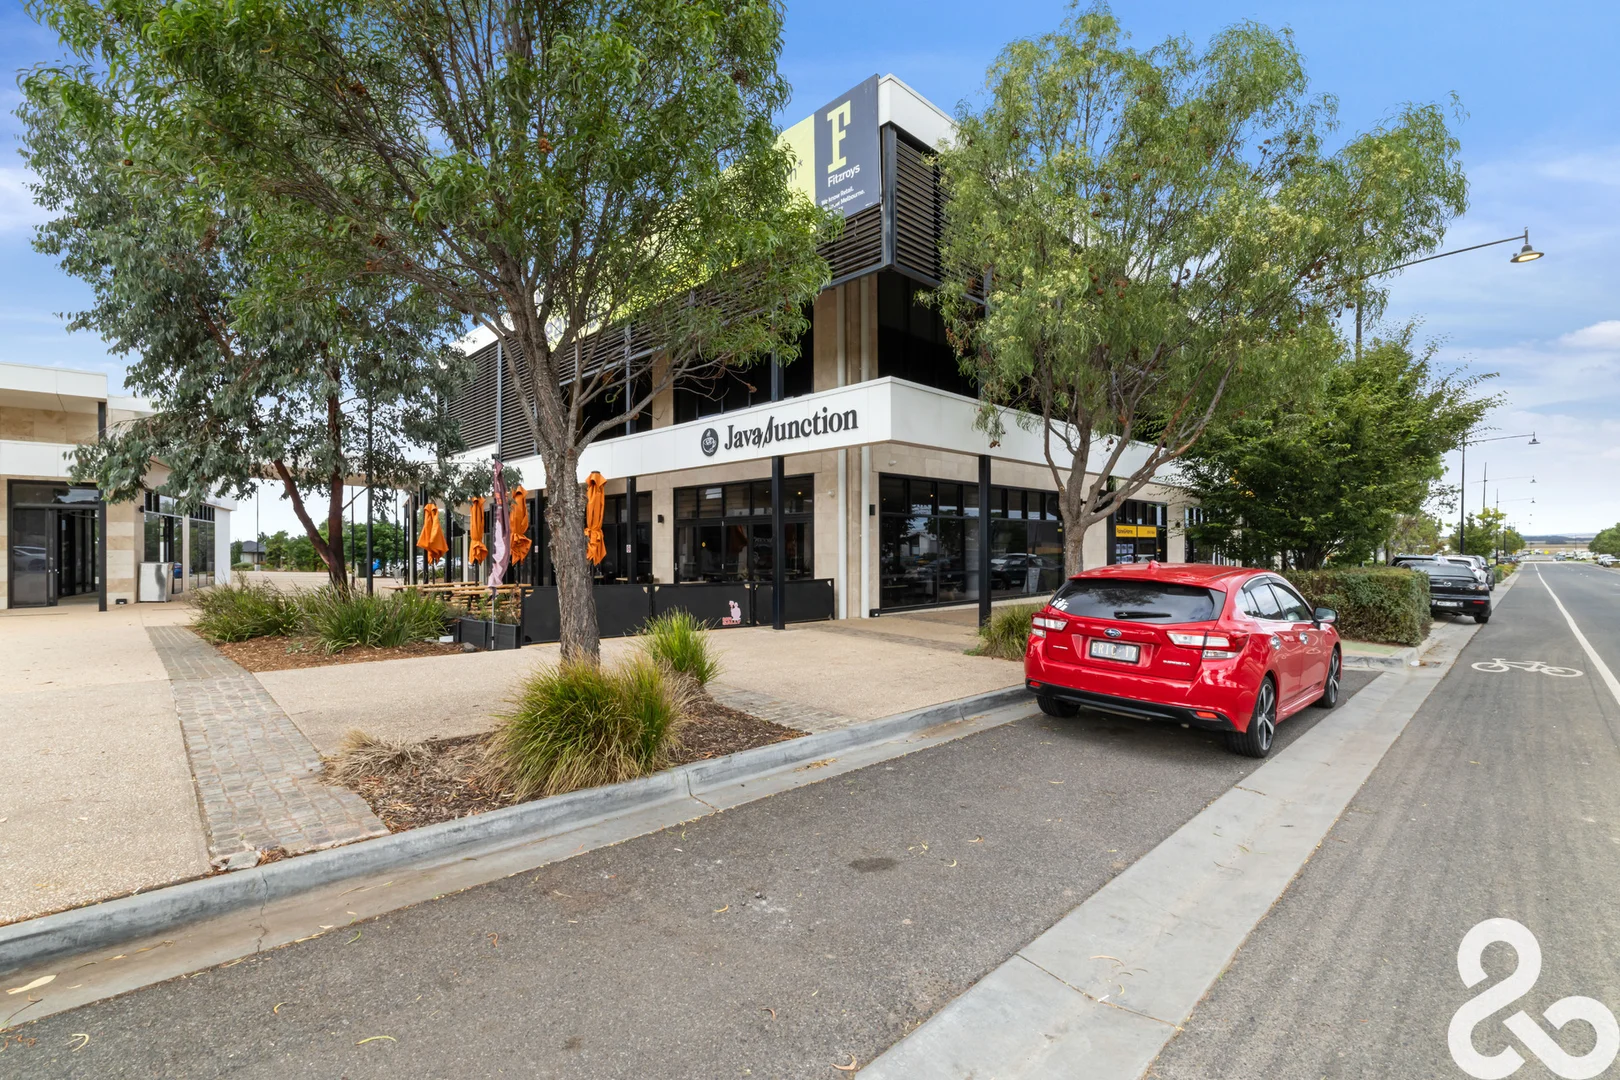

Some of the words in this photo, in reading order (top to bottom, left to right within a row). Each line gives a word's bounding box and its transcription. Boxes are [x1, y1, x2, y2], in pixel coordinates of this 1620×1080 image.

[827, 100, 851, 174] F
[828, 164, 860, 187] Fitzroys
[840, 189, 866, 204] Melbourne.
[1092, 642, 1117, 656] ERIC
[1125, 645, 1137, 659] 17
